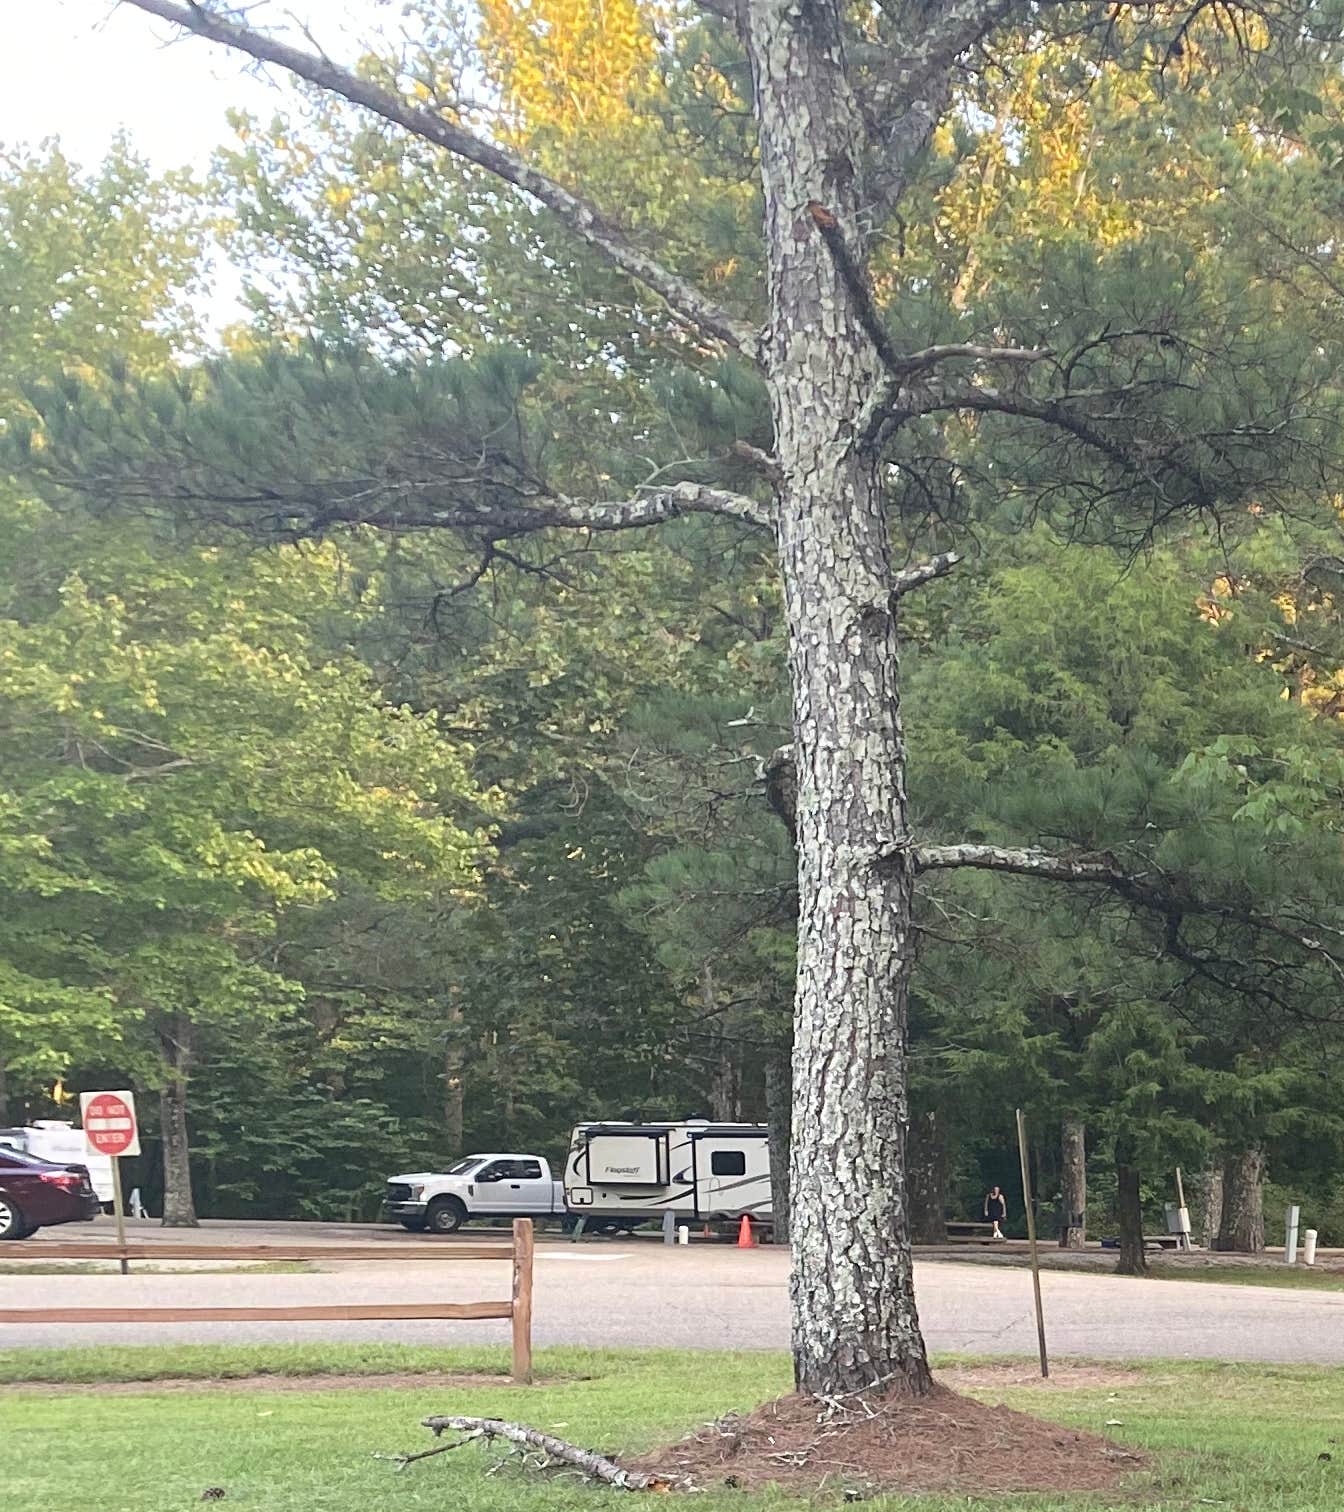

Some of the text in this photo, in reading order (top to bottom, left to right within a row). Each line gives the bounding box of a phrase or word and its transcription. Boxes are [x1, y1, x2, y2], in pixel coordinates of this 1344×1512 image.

[89, 1104, 125, 1116] DO NOT
[95, 1132, 126, 1144] ENTER
